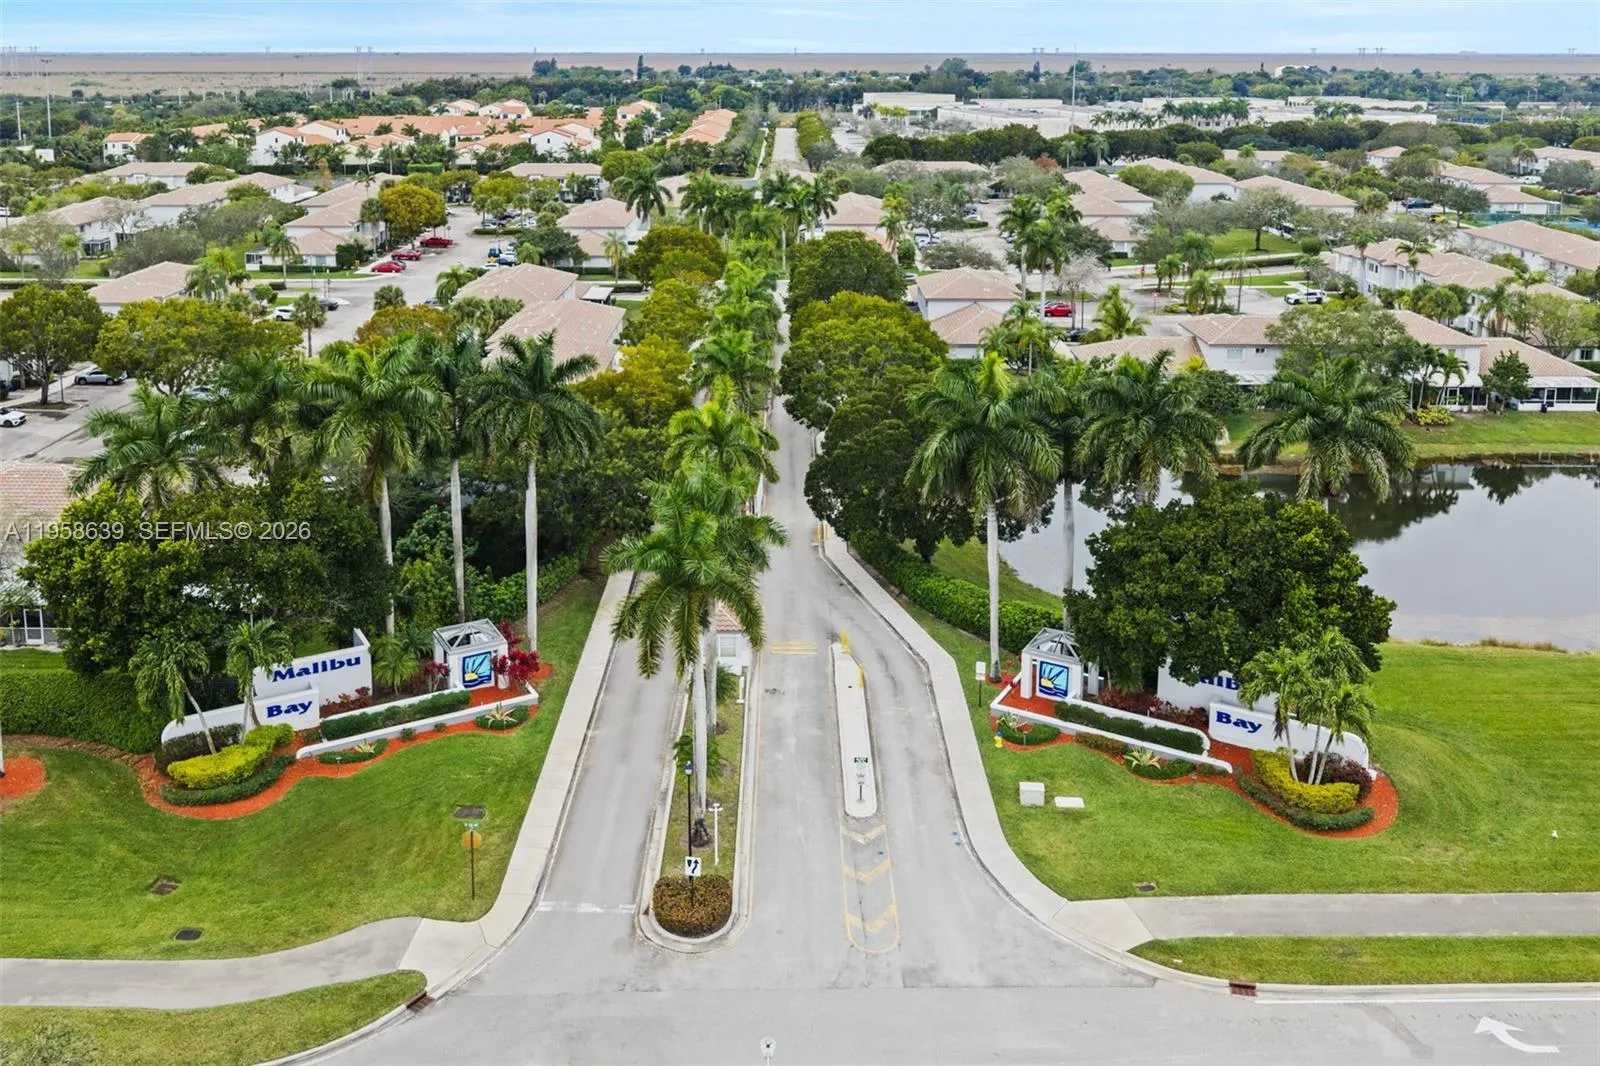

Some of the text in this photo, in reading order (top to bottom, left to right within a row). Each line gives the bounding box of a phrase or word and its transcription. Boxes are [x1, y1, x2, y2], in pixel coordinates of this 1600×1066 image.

[272, 656, 361, 682] Malibu
[266, 701, 312, 718] Bay
[1215, 711, 1262, 734] Bay
